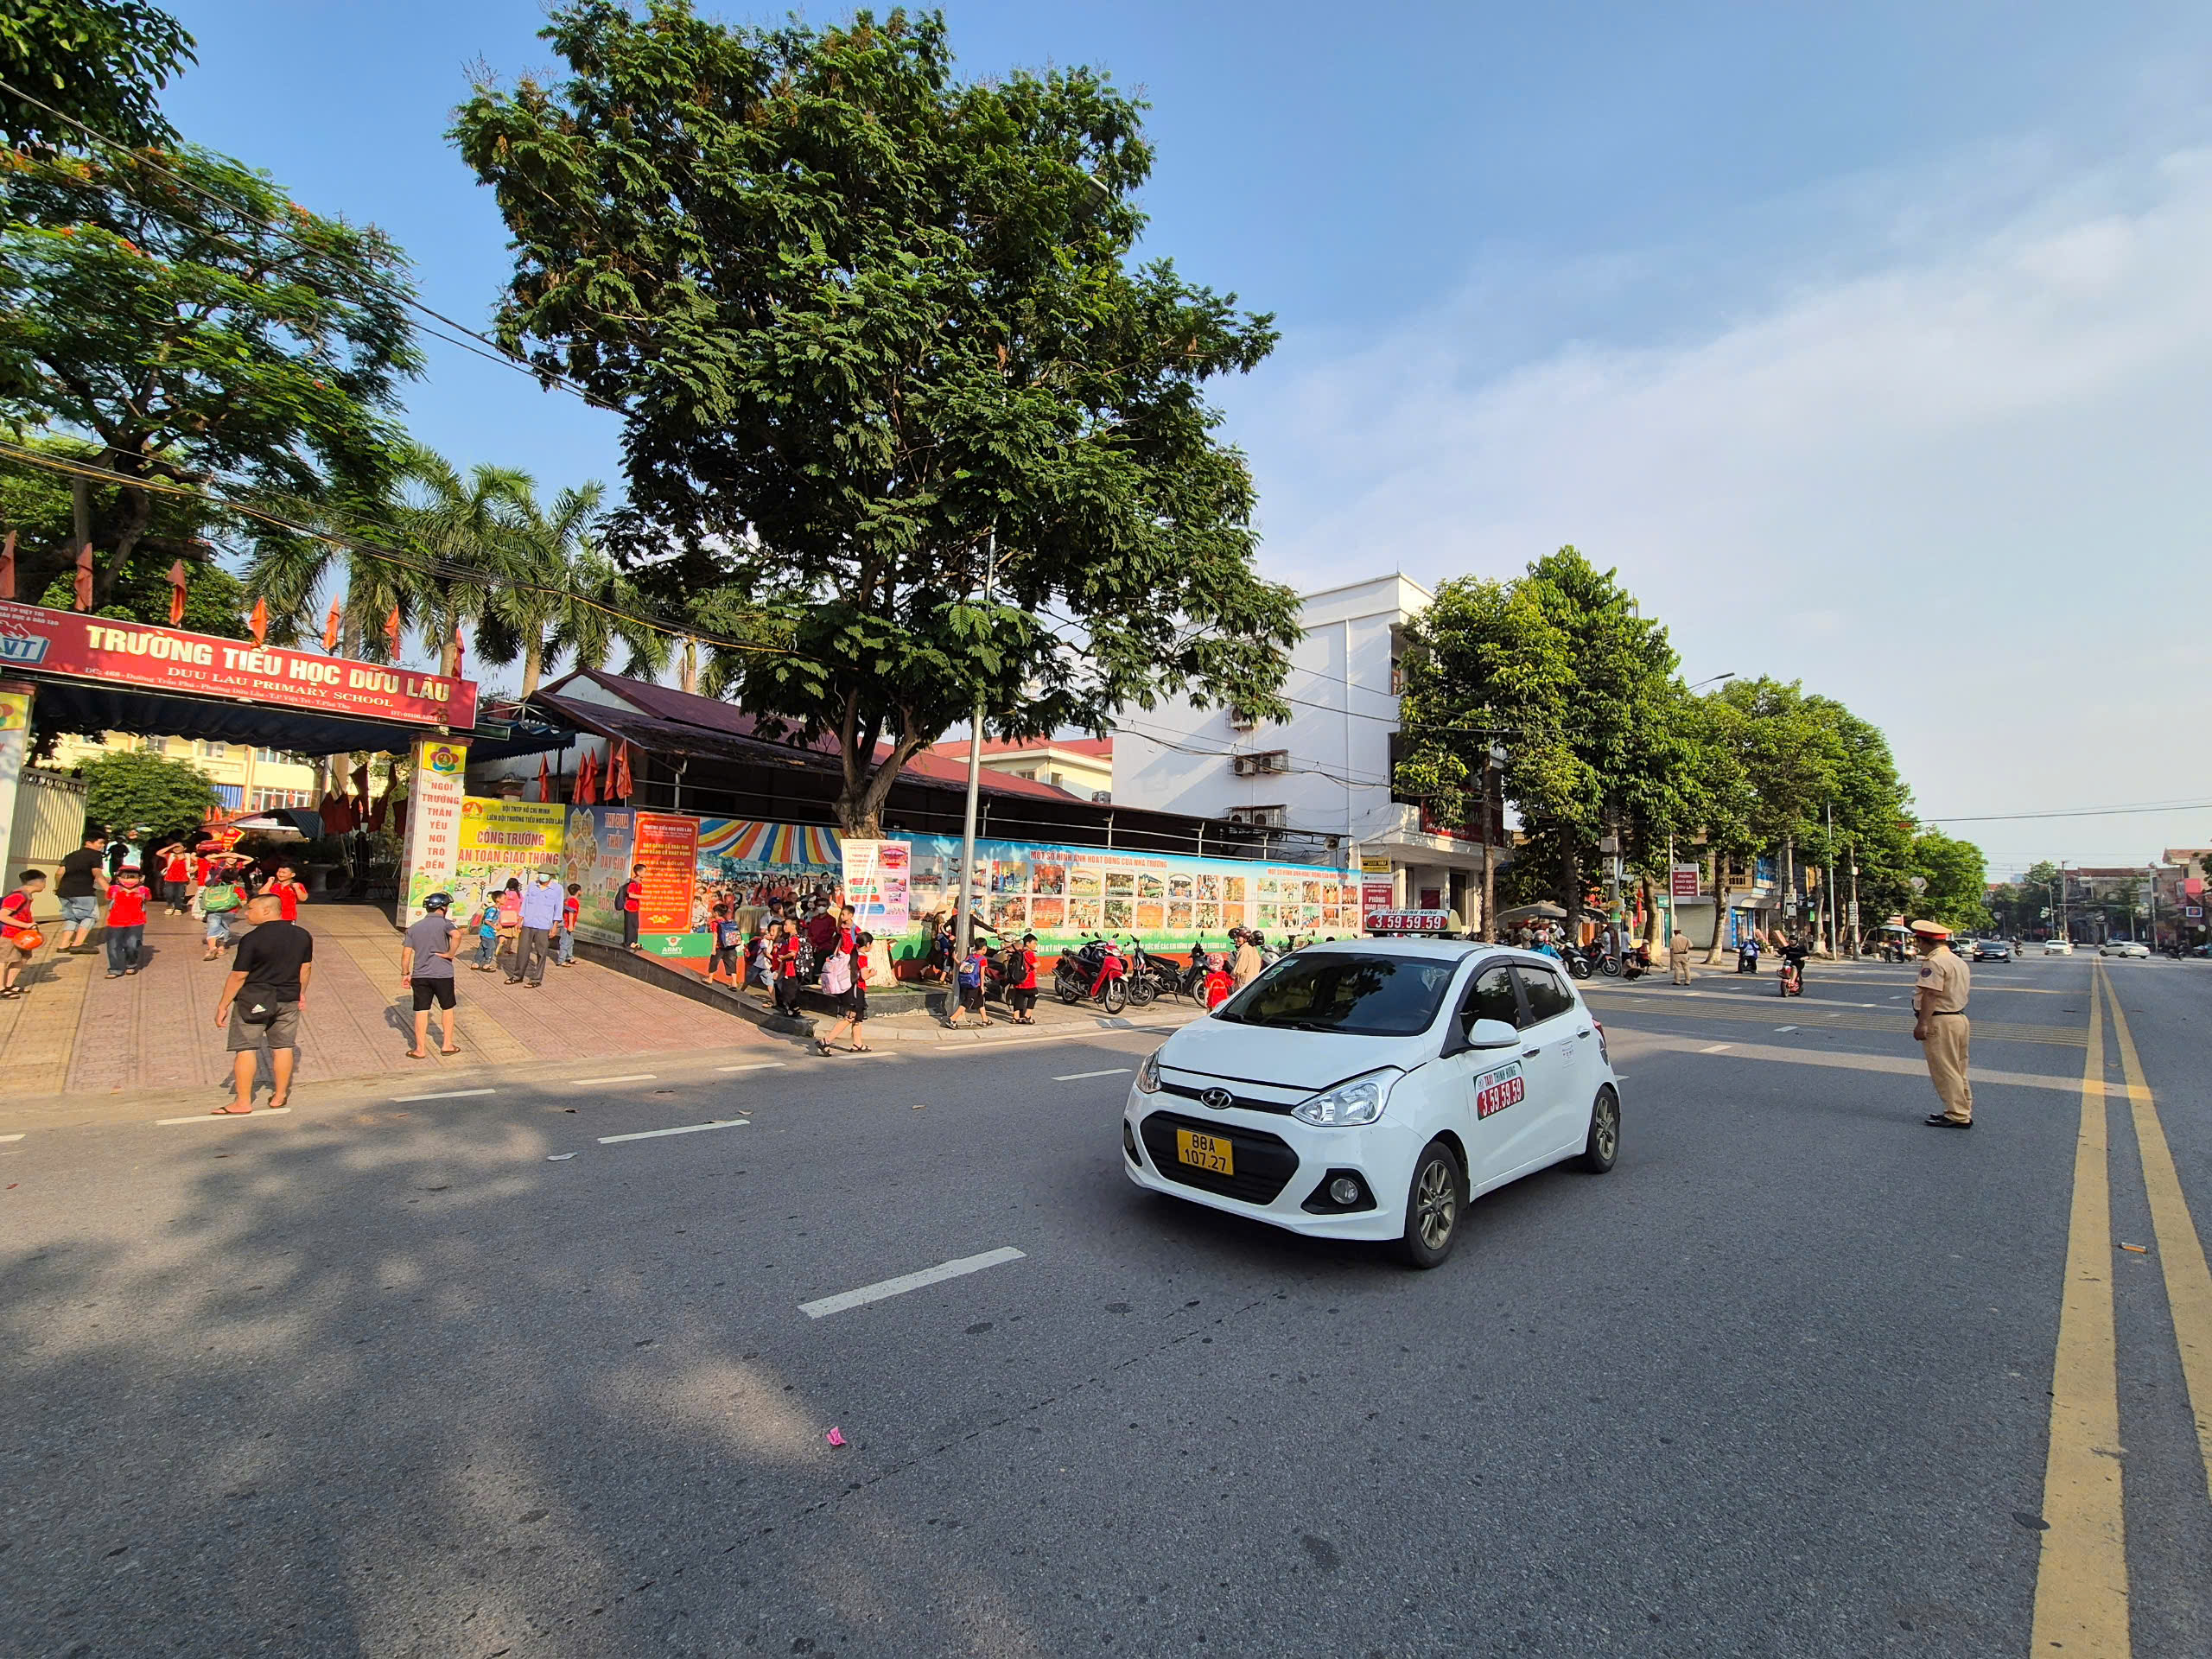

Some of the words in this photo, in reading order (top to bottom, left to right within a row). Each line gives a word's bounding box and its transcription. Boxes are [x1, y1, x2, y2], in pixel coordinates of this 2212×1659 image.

[86, 625, 213, 666] TRƯỜNG
[223, 645, 283, 677] TIỂU
[289, 658, 341, 687] HỌC
[349, 668, 400, 695] DỮU
[406, 677, 450, 702] LÂU
[168, 667, 207, 680] DUU
[213, 673, 248, 686] LAU
[253, 679, 327, 698] PRIMARY
[334, 691, 394, 708] SCHOOL
[431, 782, 454, 791] NGÔI
[422, 793, 460, 804] TRƯỜNG
[429, 820, 448, 830] YÊU
[429, 834, 446, 843] NƠI
[477, 825, 505, 844] CỔNG
[506, 830, 545, 846] TRƯỜNG
[457, 849, 473, 861] AN
[475, 848, 501, 862] TOÀN
[503, 850, 526, 864] GIAO
[528, 850, 560, 865] THÔNG
[1375, 916, 1442, 930] 3.59.59.59
[1484, 1073, 1494, 1087] TAXI
[1482, 1077, 1522, 1117] 3.59.59.59
[1192, 1134, 1215, 1153] 88A
[1185, 1148, 1226, 1172] 107.27
